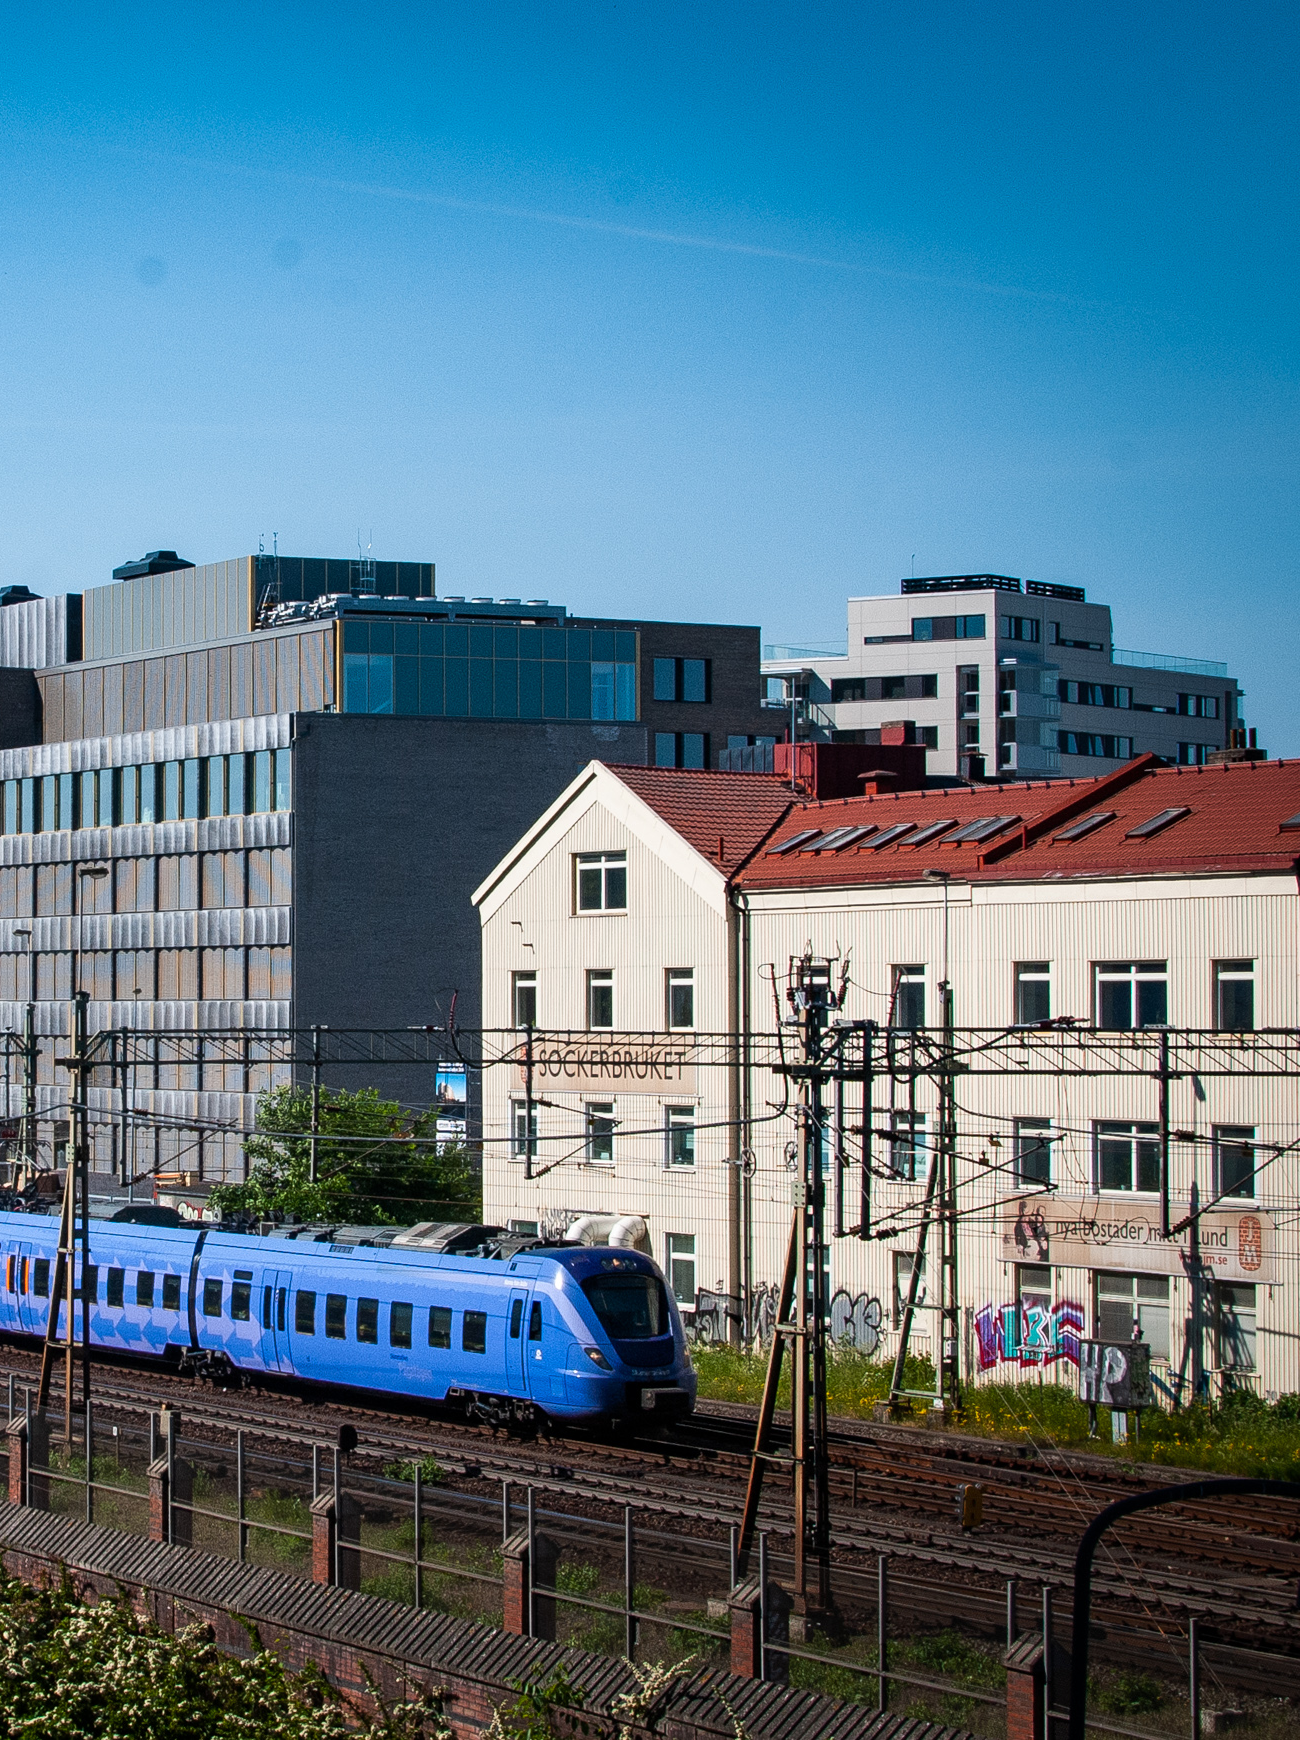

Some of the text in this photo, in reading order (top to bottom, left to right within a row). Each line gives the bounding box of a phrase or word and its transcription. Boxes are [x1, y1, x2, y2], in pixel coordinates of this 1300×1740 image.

[539, 1050, 686, 1080] SOCKERBRUKET
[1083, 1216, 1144, 1240] bostäder
[1148, 1226, 1179, 1243] mt
